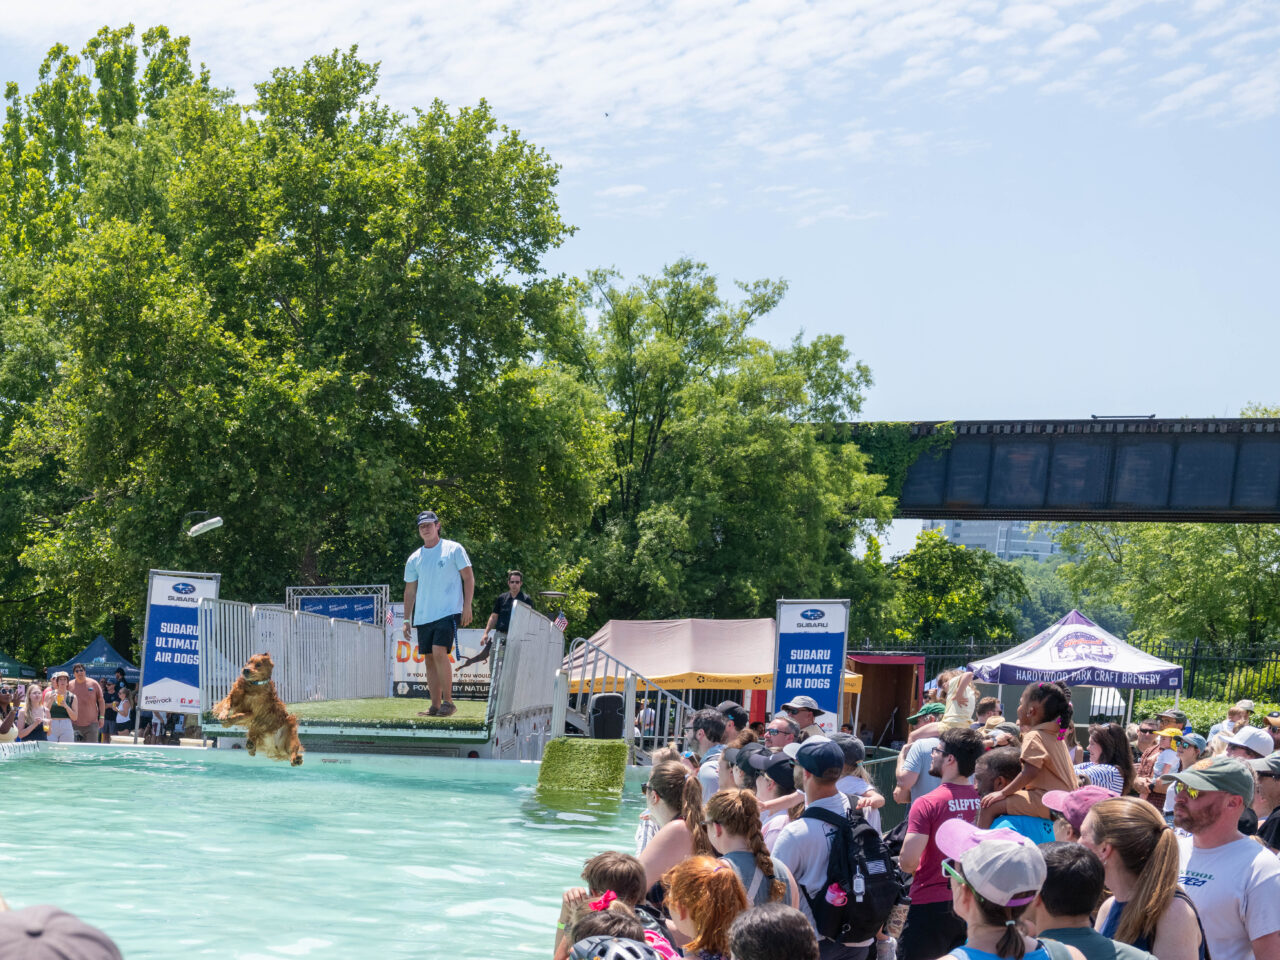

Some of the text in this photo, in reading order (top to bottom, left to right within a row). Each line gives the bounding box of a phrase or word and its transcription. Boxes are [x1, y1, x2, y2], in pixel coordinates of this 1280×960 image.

[168, 595, 199, 603] SUBARU
[160, 622, 199, 636] SUBARU
[154, 652, 199, 664] AIR DOGS
[790, 649, 831, 660] SUBARU
[785, 664, 833, 675] ULTIMATE
[1016, 670, 1161, 685] HARDYWOOD PARK CRAFT BREWERY
[785, 678, 802, 689] AIR
[804, 678, 831, 689] DOGS
